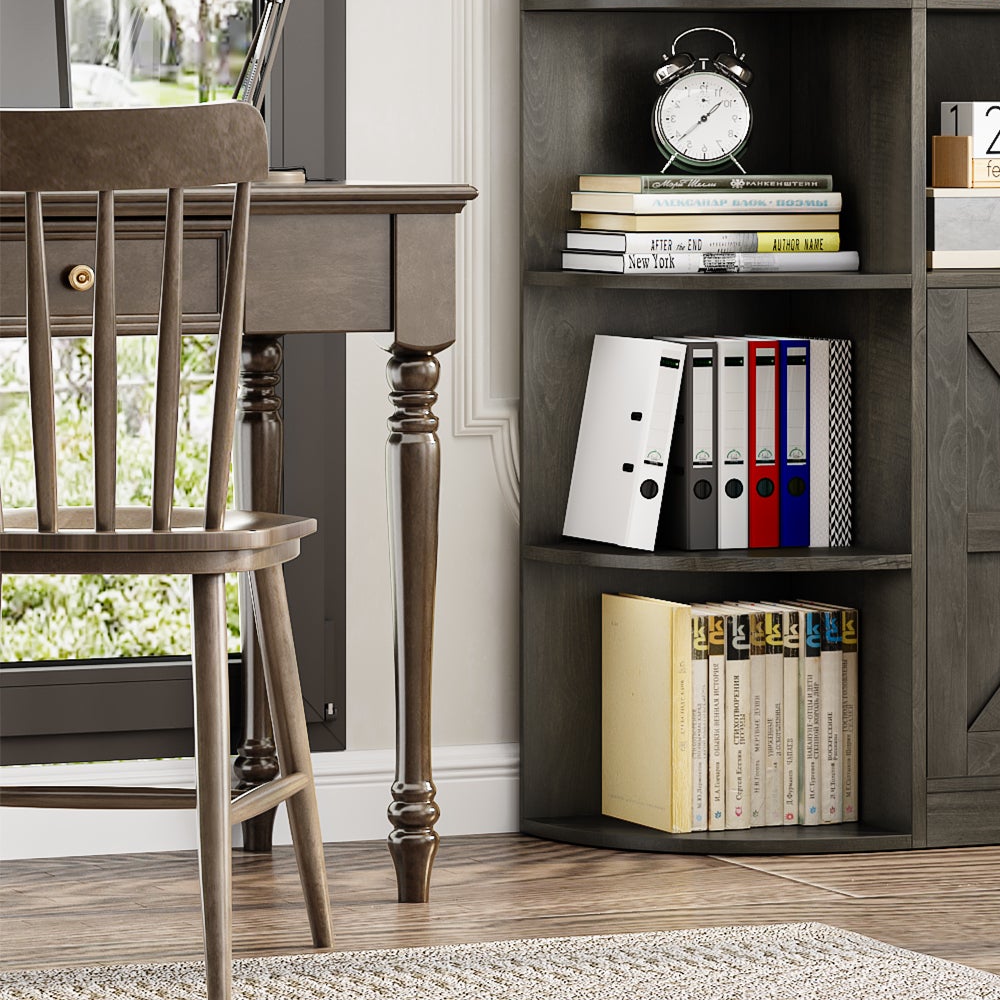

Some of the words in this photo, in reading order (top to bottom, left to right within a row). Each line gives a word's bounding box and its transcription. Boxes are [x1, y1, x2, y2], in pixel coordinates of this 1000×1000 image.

[651, 238, 673, 251] AFTER
[675, 243, 686, 251] the
[688, 238, 703, 251] END
[772, 238, 800, 251] AUTHOR
[804, 238, 824, 251] NAME
[628, 252, 650, 269] New
[651, 252, 675, 270] York
